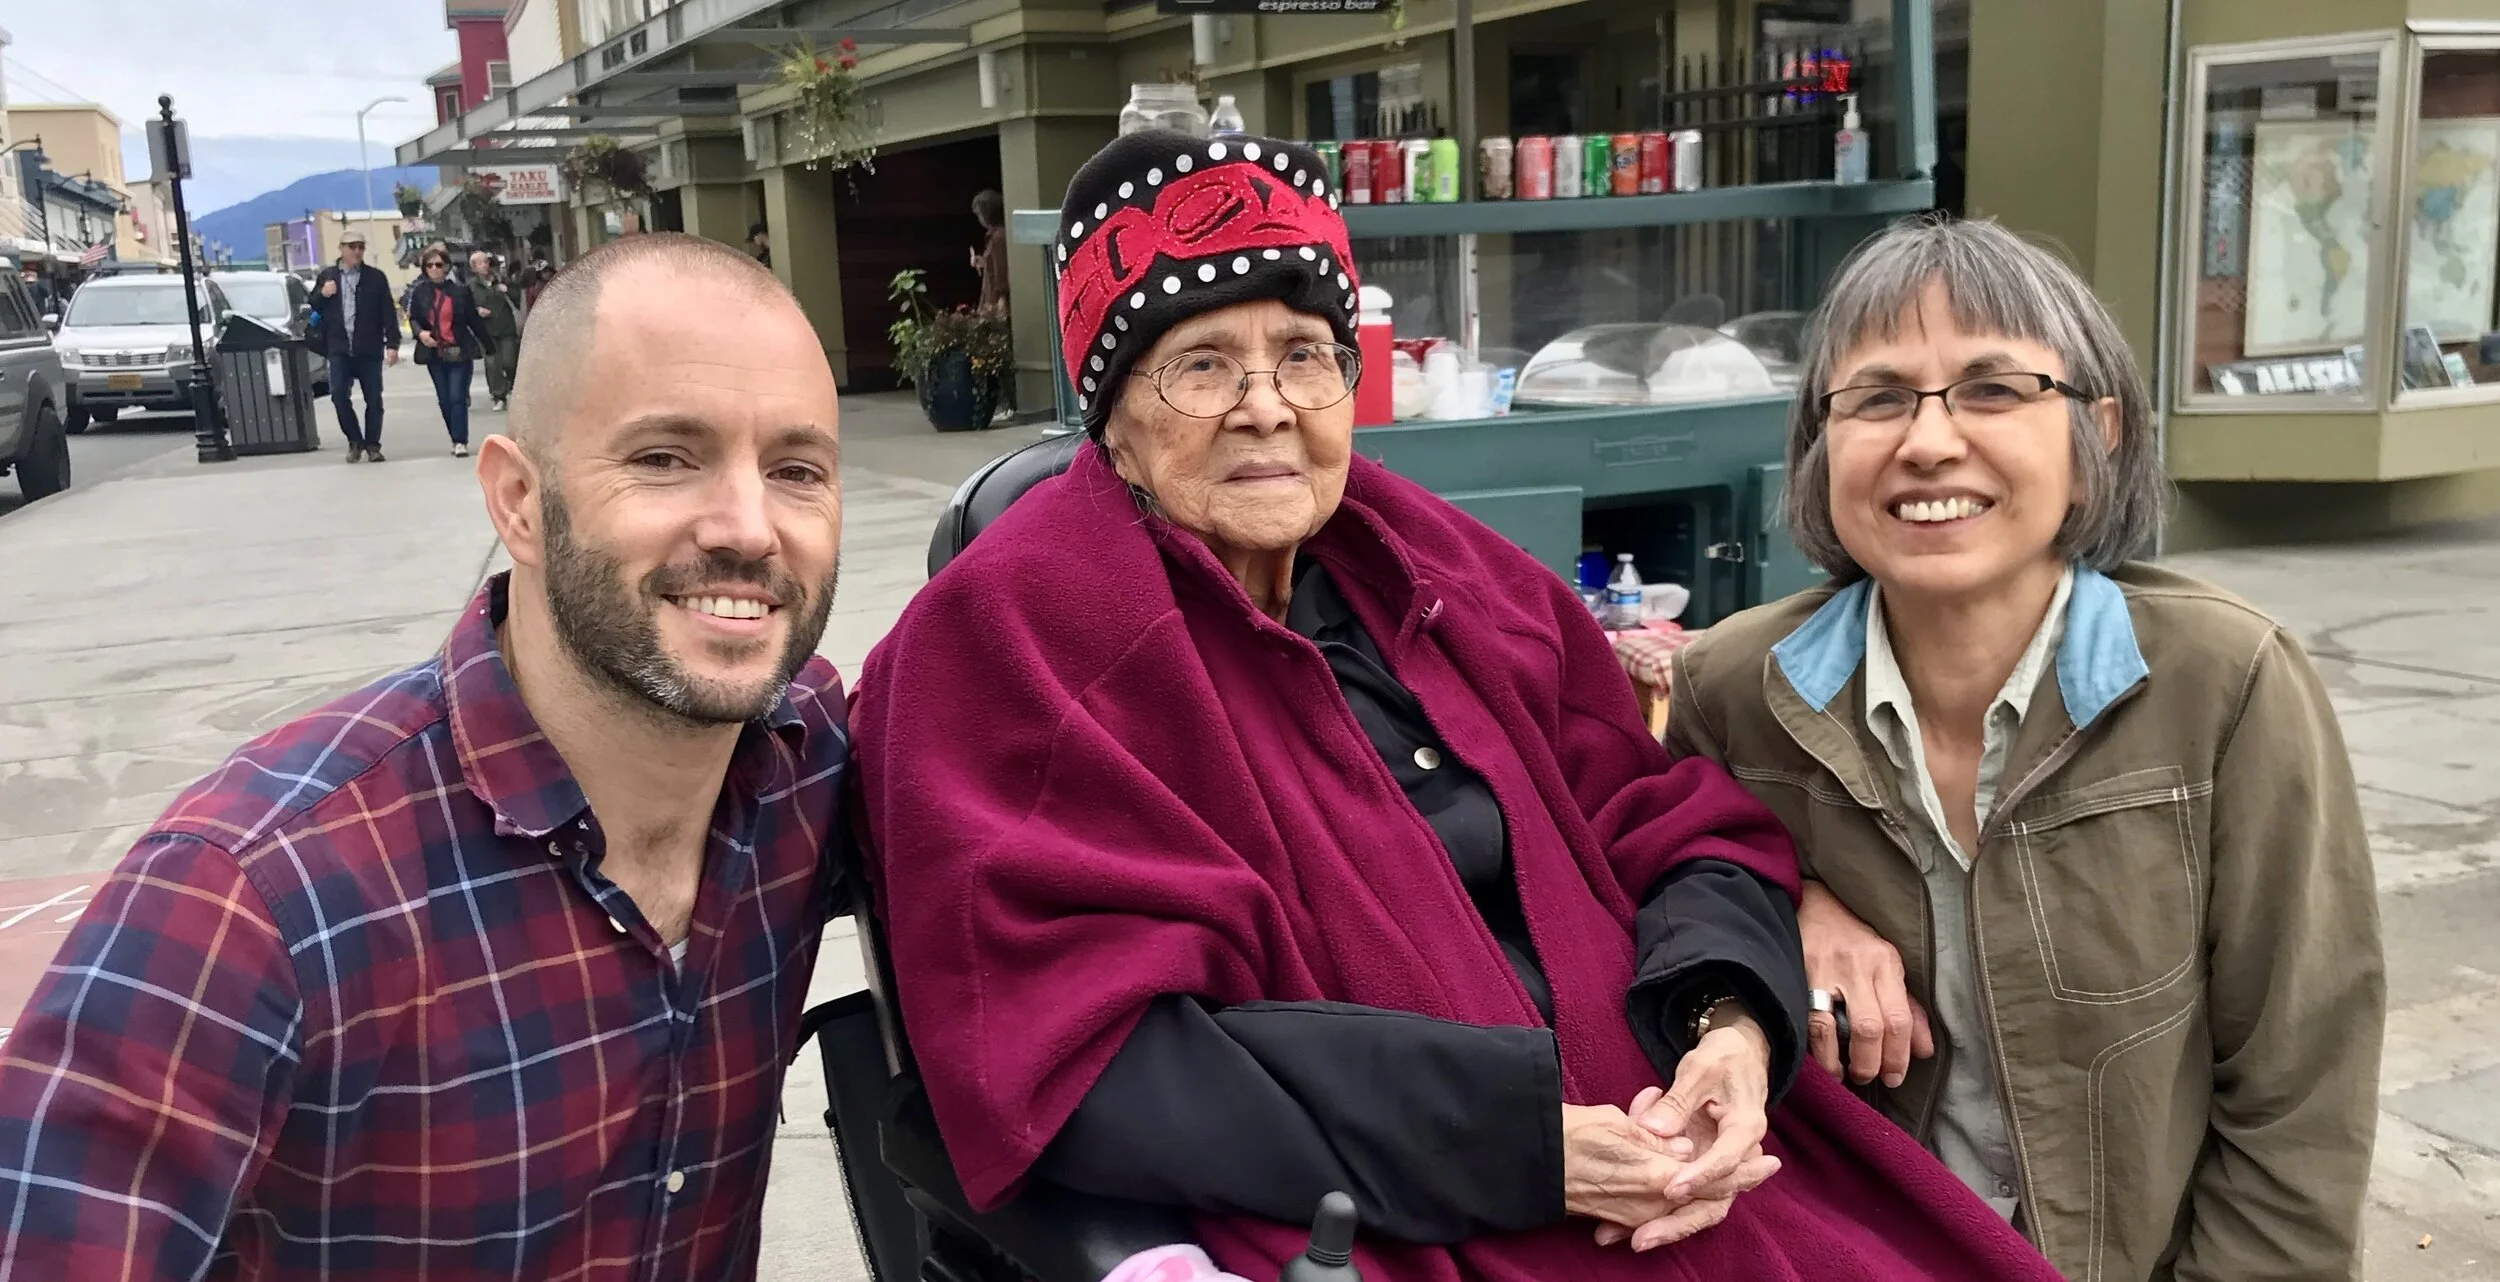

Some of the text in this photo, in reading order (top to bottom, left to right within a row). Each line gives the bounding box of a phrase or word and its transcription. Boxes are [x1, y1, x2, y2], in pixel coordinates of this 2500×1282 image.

[1258, 0, 1377, 13] espresso bar
[510, 171, 547, 181] TAKU
